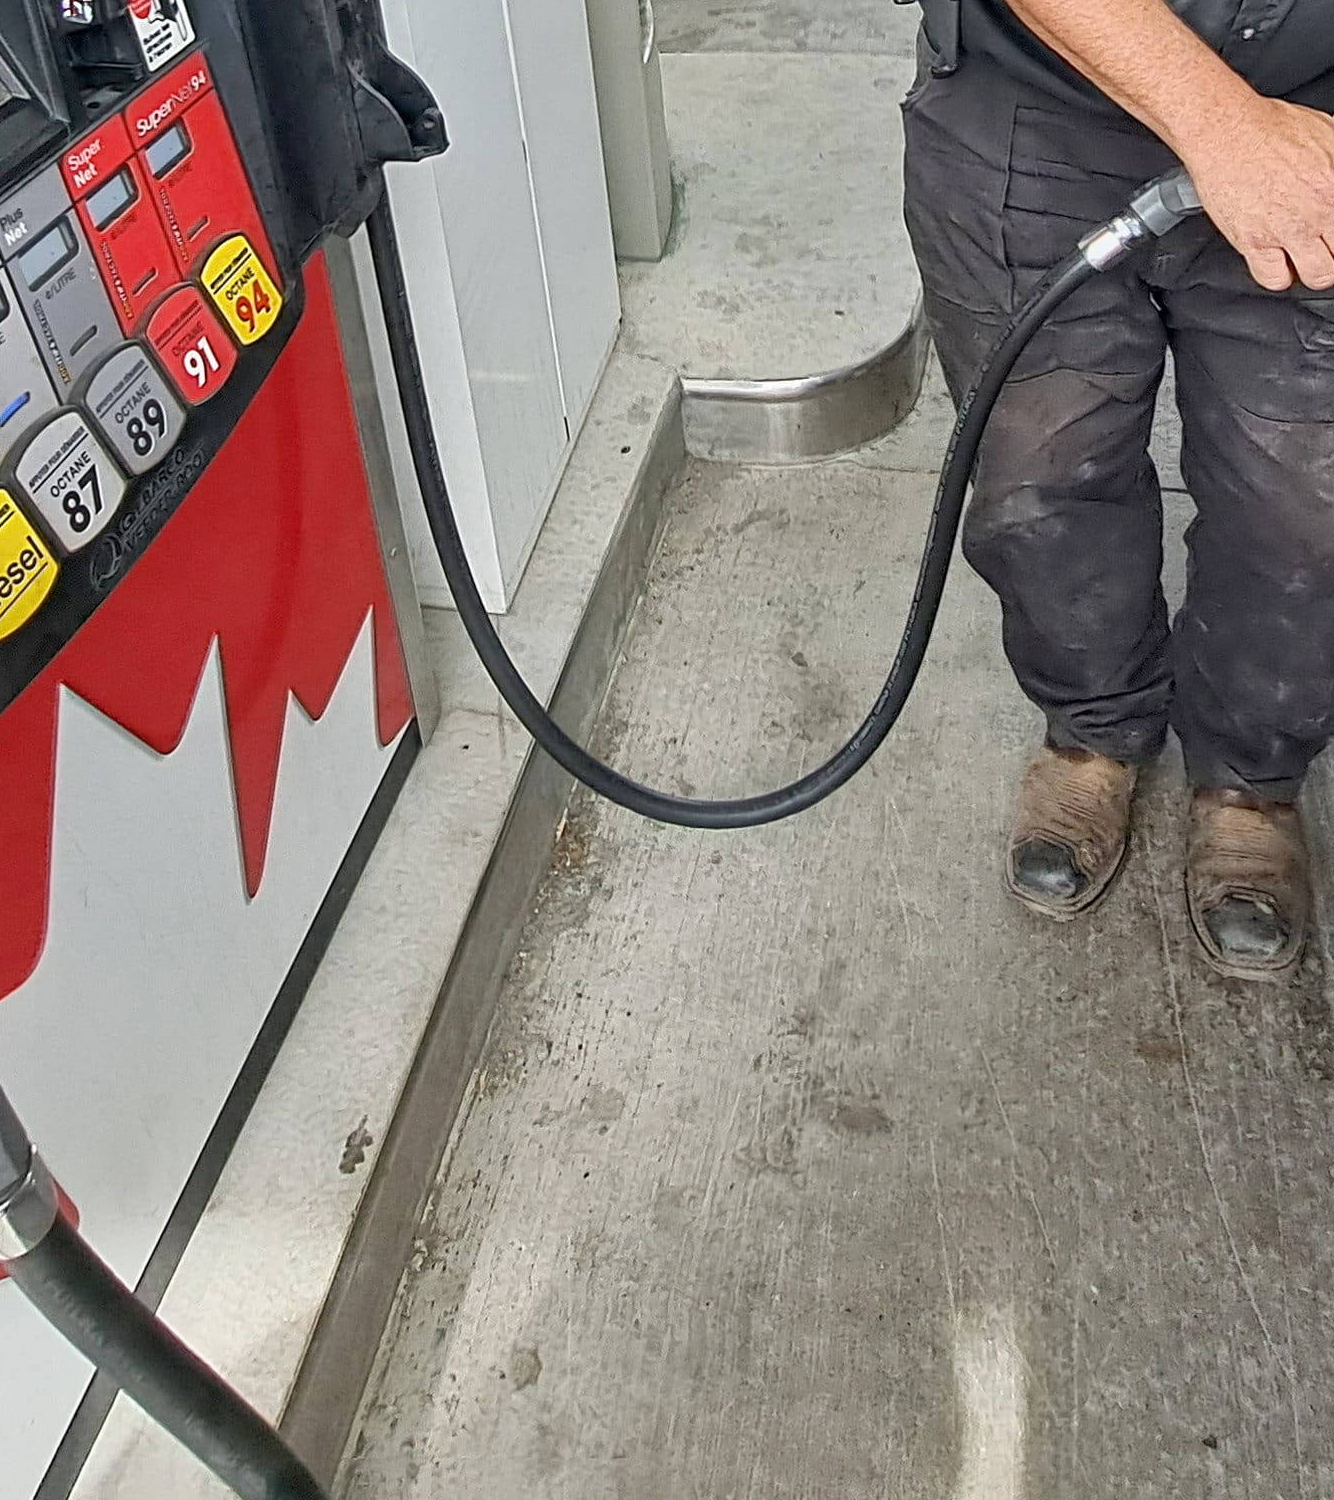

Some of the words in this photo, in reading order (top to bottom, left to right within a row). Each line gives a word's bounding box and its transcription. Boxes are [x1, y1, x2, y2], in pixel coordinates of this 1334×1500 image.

[67, 139, 101, 171] Super
[73, 164, 98, 188] Net
[0, 208, 24, 233] Plus
[3, 222, 28, 247] Net
[225, 266, 255, 301] OCTANE
[236, 280, 271, 333] 94
[183, 336, 220, 388] 91
[115, 382, 152, 424] OCTANE
[126, 398, 168, 456] 89
[50, 451, 91, 498] OCTANE
[62, 464, 104, 533] 87
